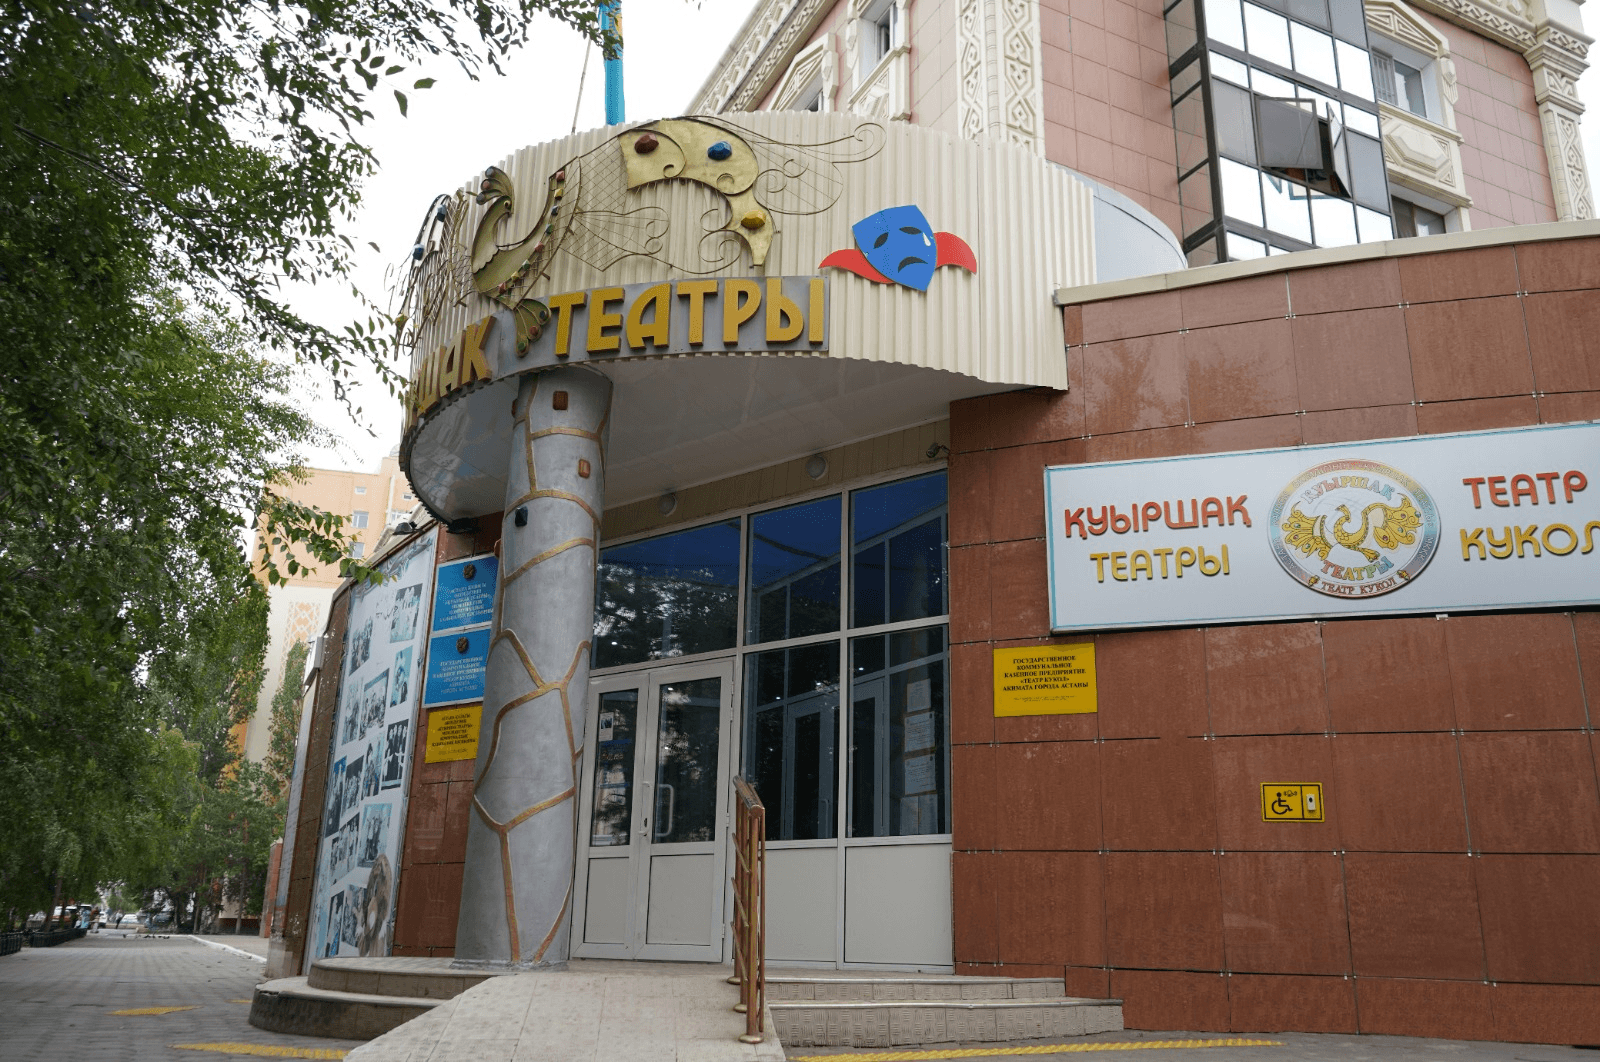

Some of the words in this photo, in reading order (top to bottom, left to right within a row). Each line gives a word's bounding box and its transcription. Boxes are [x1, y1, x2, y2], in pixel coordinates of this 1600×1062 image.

[404, 316, 497, 430] ШАК
[549, 277, 826, 357] ТЕАТРЫ
[1462, 470, 1588, 509] ТЕАТР
[1064, 495, 1252, 540] ҚУЫРШАҚ
[1089, 543, 1230, 583] ТЕАТРЫ
[1321, 555, 1394, 581] ТЕАТРЫ
[1321, 582, 1354, 595] ТЕАТР
[1360, 576, 1398, 595] КУКОЛ
